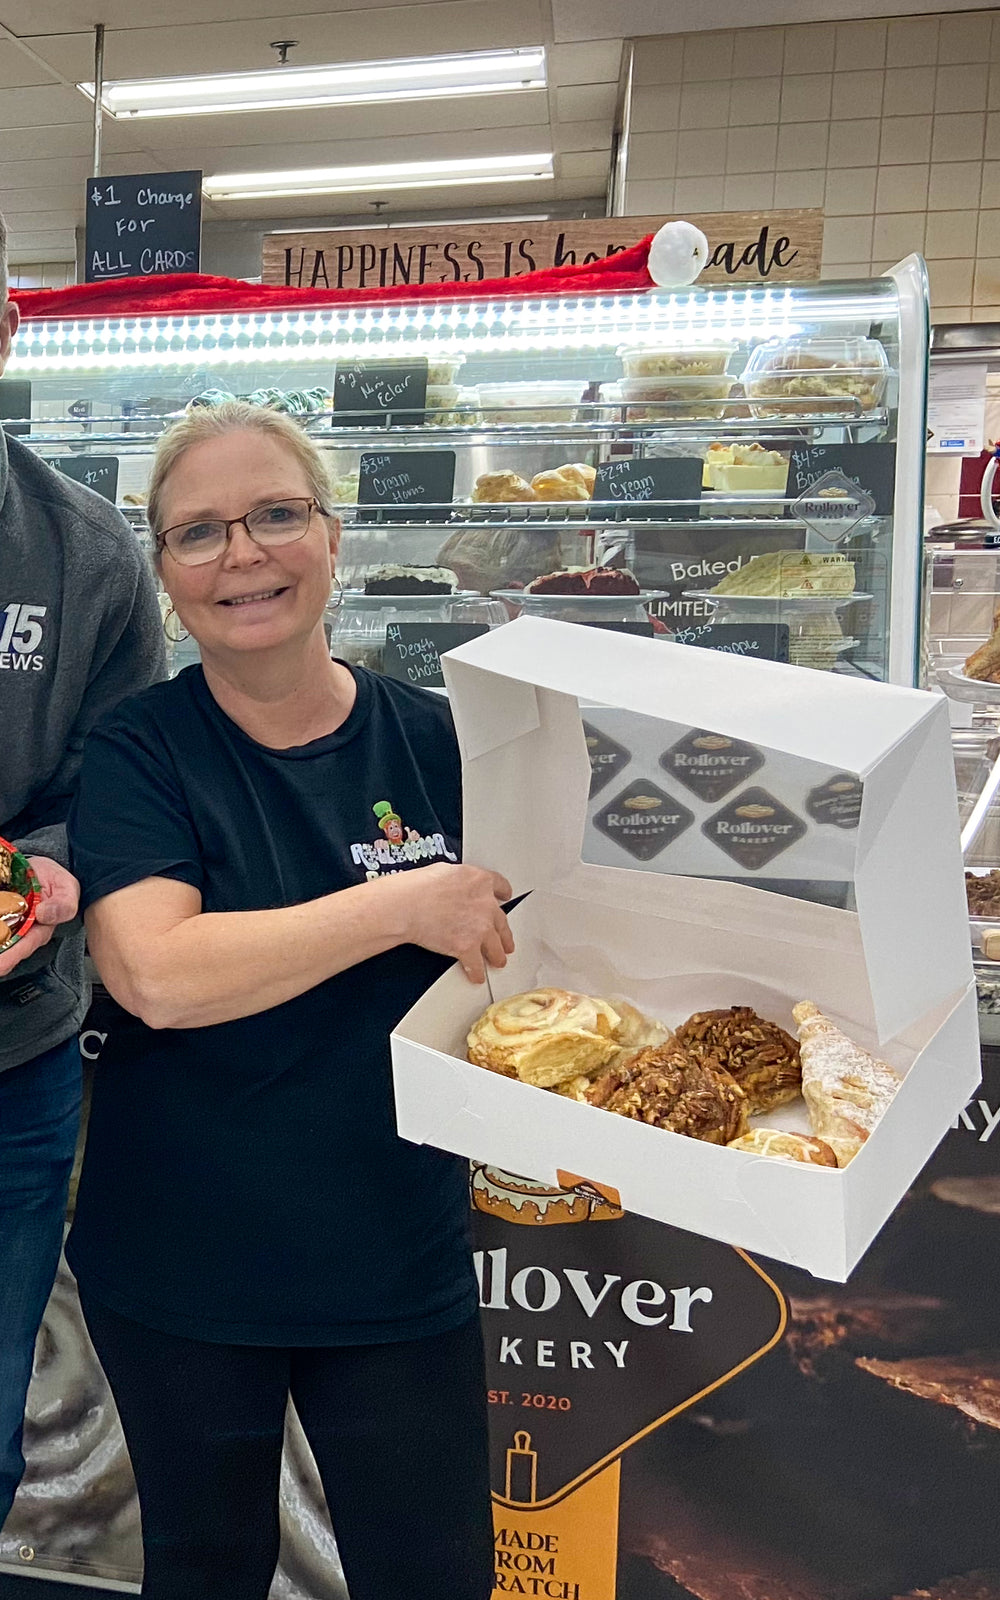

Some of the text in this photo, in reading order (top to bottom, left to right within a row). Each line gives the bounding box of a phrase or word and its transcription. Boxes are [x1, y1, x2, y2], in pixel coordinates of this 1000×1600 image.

[91, 185, 121, 207] $1
[92, 250, 132, 273] ALL
[284, 239, 484, 288] HAPPINESS
[373, 473, 410, 496] Cream
[609, 475, 655, 498] Cream
[671, 555, 742, 581] Baked
[648, 600, 716, 618] LIMITED
[0, 603, 47, 654] 15
[396, 638, 435, 659] Death
[421, 650, 440, 665] by
[0, 652, 44, 672] EWS
[674, 753, 751, 767] Rollover
[607, 813, 681, 827] Rollover
[717, 821, 793, 835] Rollover
[473, 1247, 713, 1333] llover
[499, 1336, 629, 1369] KERY
[487, 1389, 571, 1411] ST. 2020
[495, 1549, 555, 1575] ROM
[494, 1571, 580, 1600] RATCH
